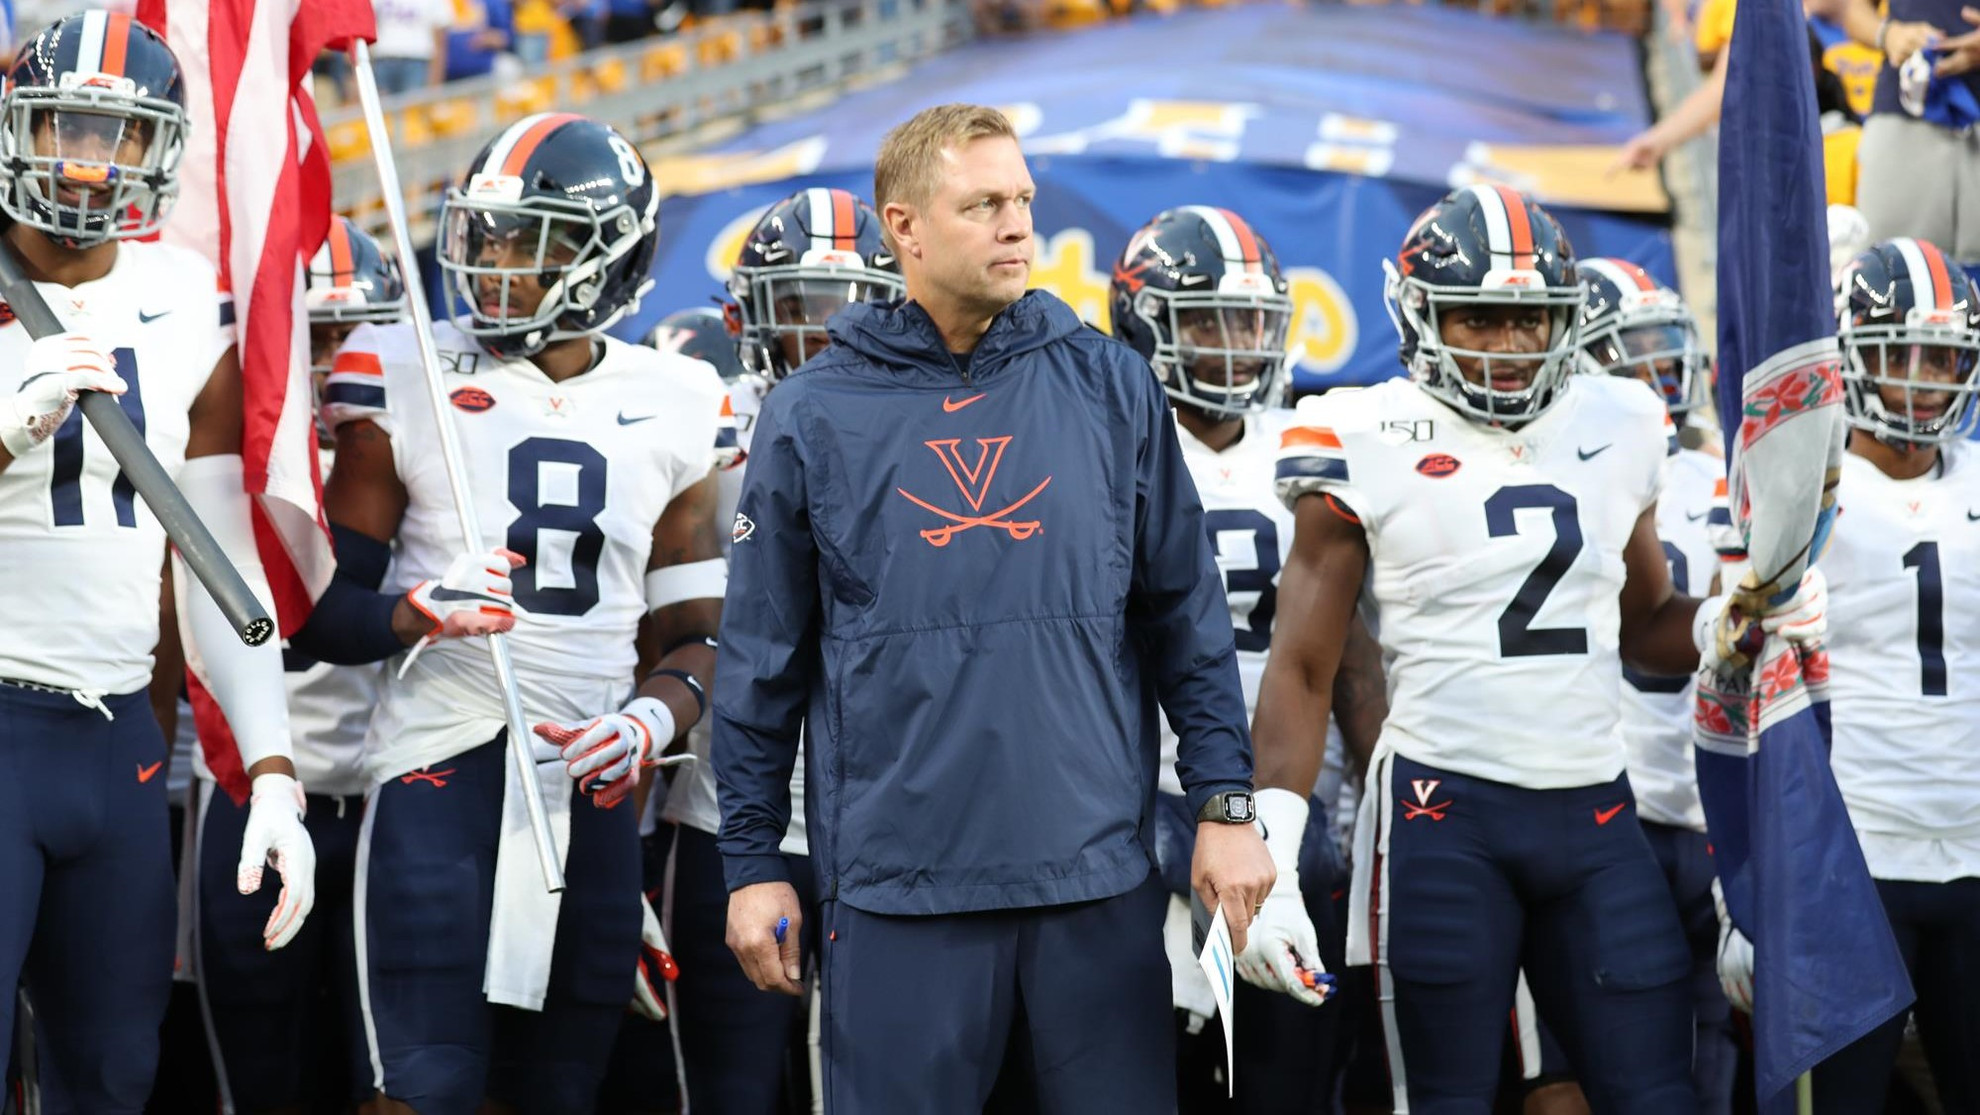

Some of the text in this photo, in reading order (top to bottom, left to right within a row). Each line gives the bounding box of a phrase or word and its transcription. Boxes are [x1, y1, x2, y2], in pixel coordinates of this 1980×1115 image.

[608, 136, 645, 187] 8
[507, 436, 607, 616] 8
[924, 434, 1013, 512] V
[1205, 509, 1281, 652] 3
[1484, 484, 1588, 658] 2
[1902, 541, 1947, 696] 1
[1411, 779, 1441, 808] V
